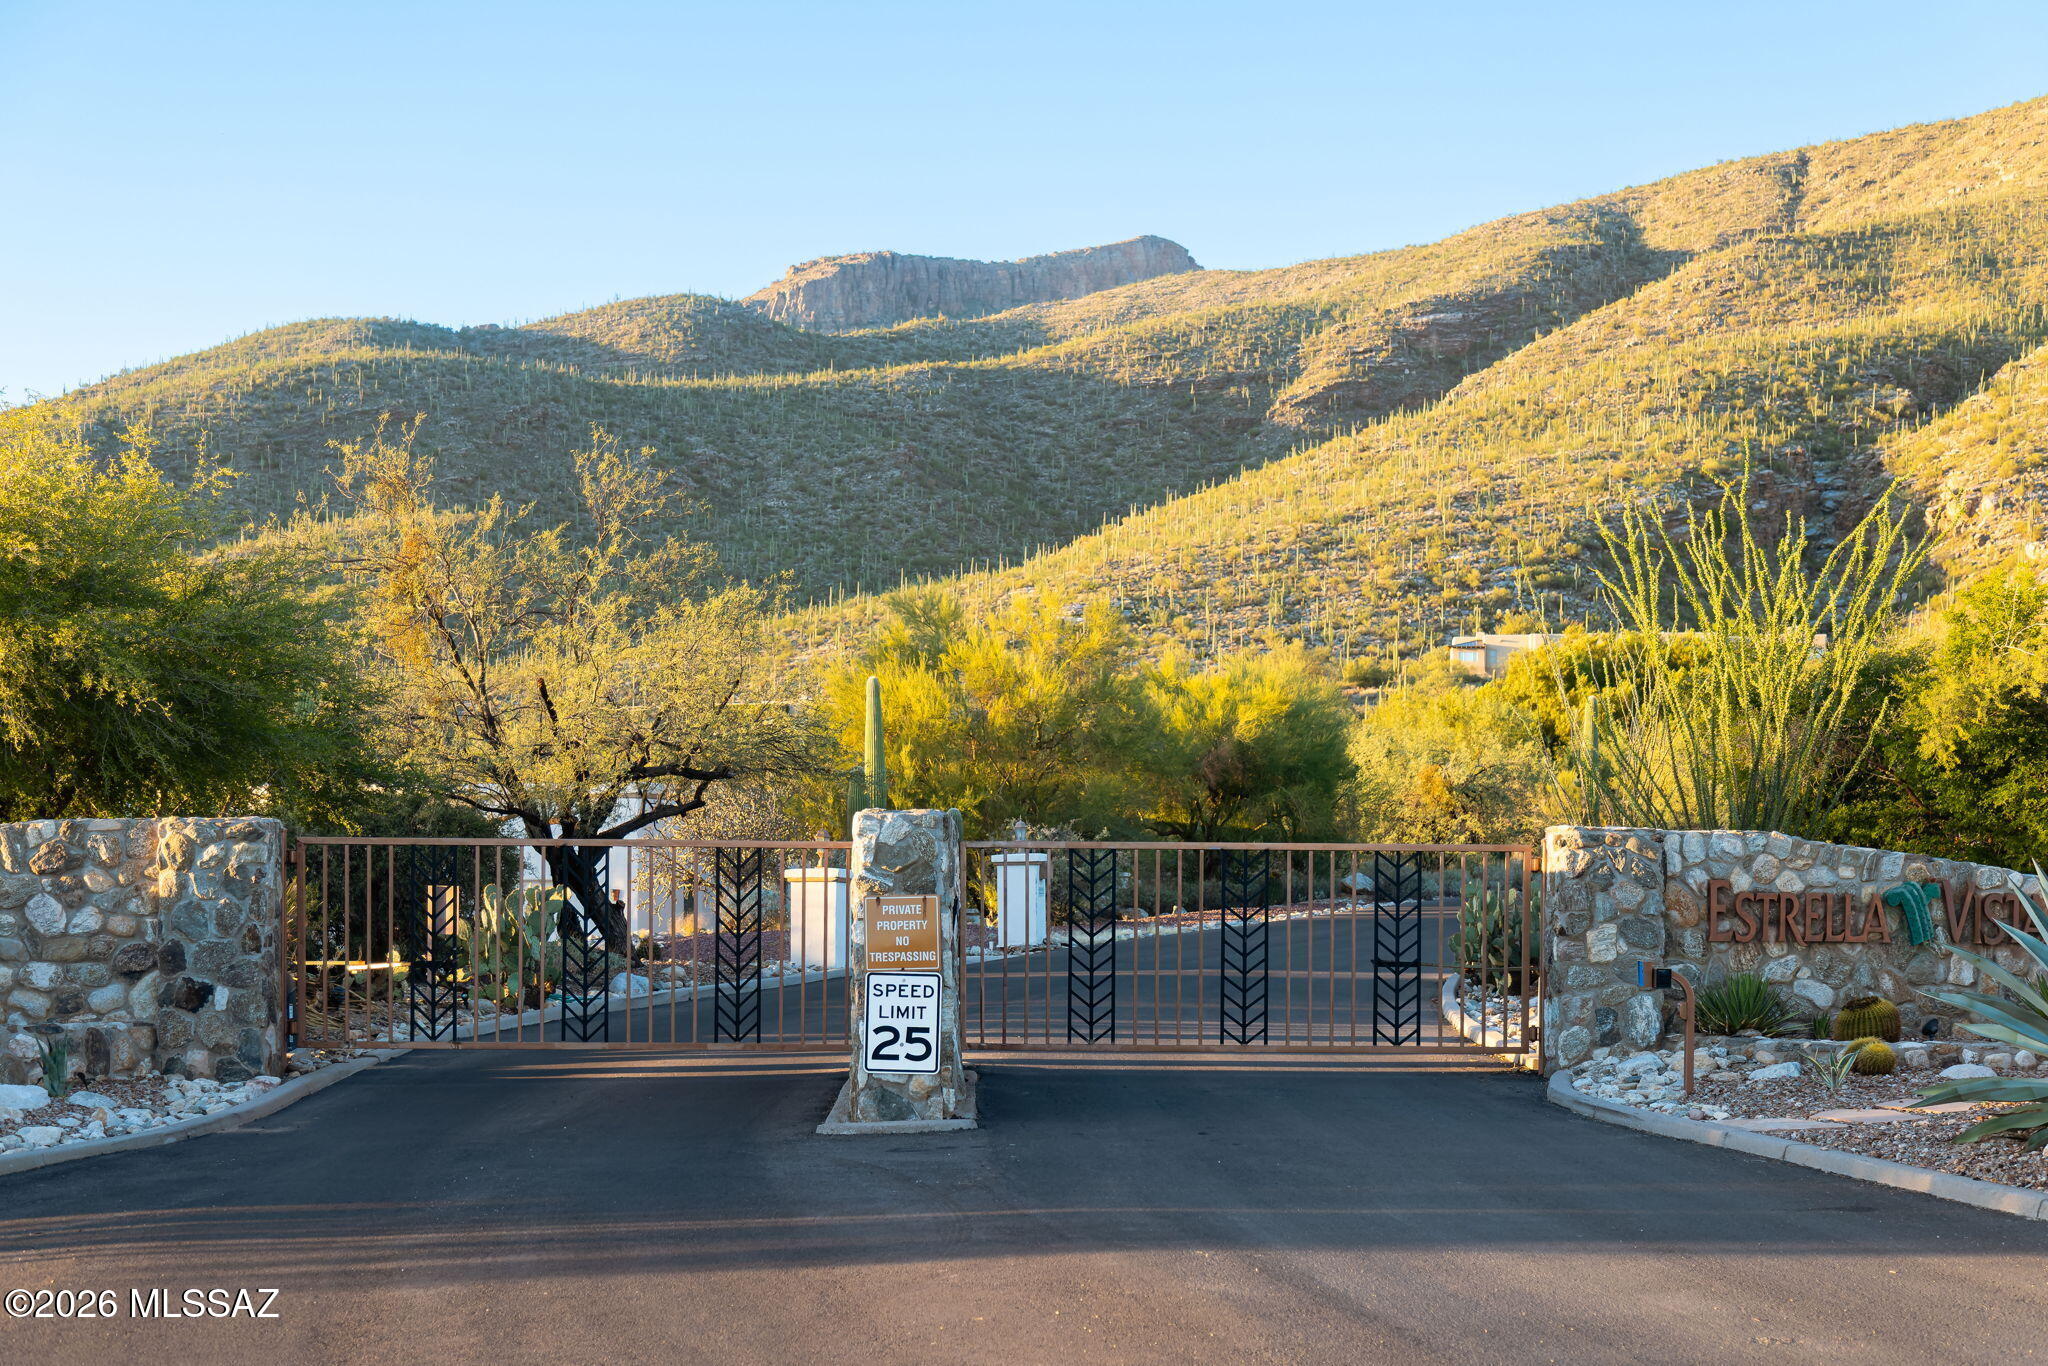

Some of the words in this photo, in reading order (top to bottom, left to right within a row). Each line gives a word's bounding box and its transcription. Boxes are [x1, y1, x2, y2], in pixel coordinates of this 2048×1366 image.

[882, 904, 922, 915] PRIVATE
[1708, 879, 1891, 946] ESTRELLA
[876, 920, 928, 931] PROPERTY
[895, 936, 910, 946] NO
[869, 951, 936, 962] TRESPASSING
[872, 983, 935, 999] SPEED
[878, 1005, 927, 1020] LIMIT
[871, 1025, 932, 1062] 25
